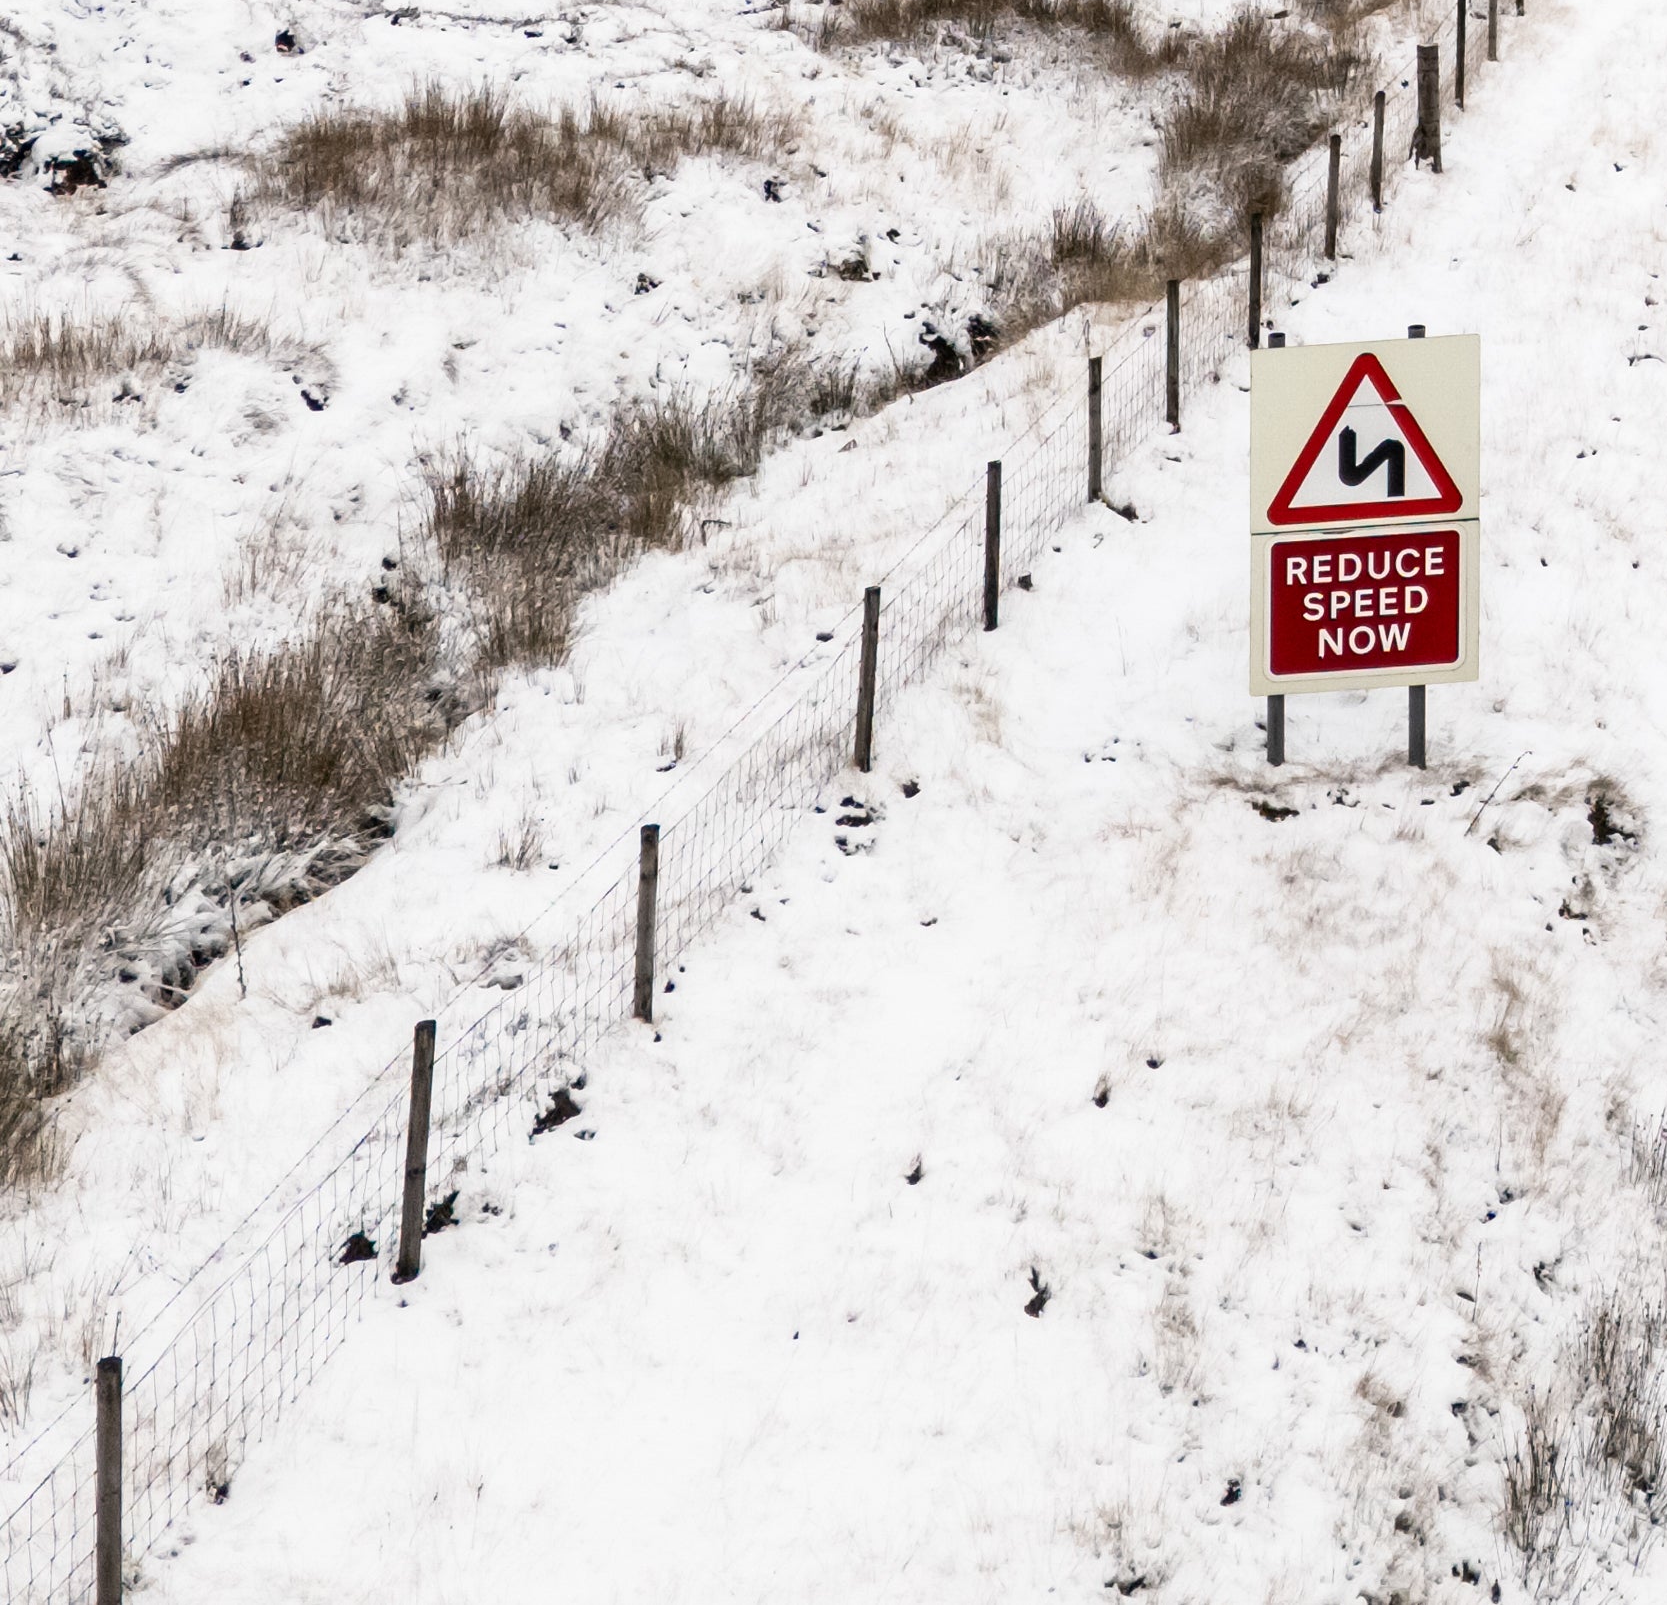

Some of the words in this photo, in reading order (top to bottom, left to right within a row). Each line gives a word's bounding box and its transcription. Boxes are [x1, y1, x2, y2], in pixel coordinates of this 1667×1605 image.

[1286, 546, 1445, 585] REDUCE
[1303, 586, 1429, 621] SPEED
[1318, 622, 1412, 658] NOW
